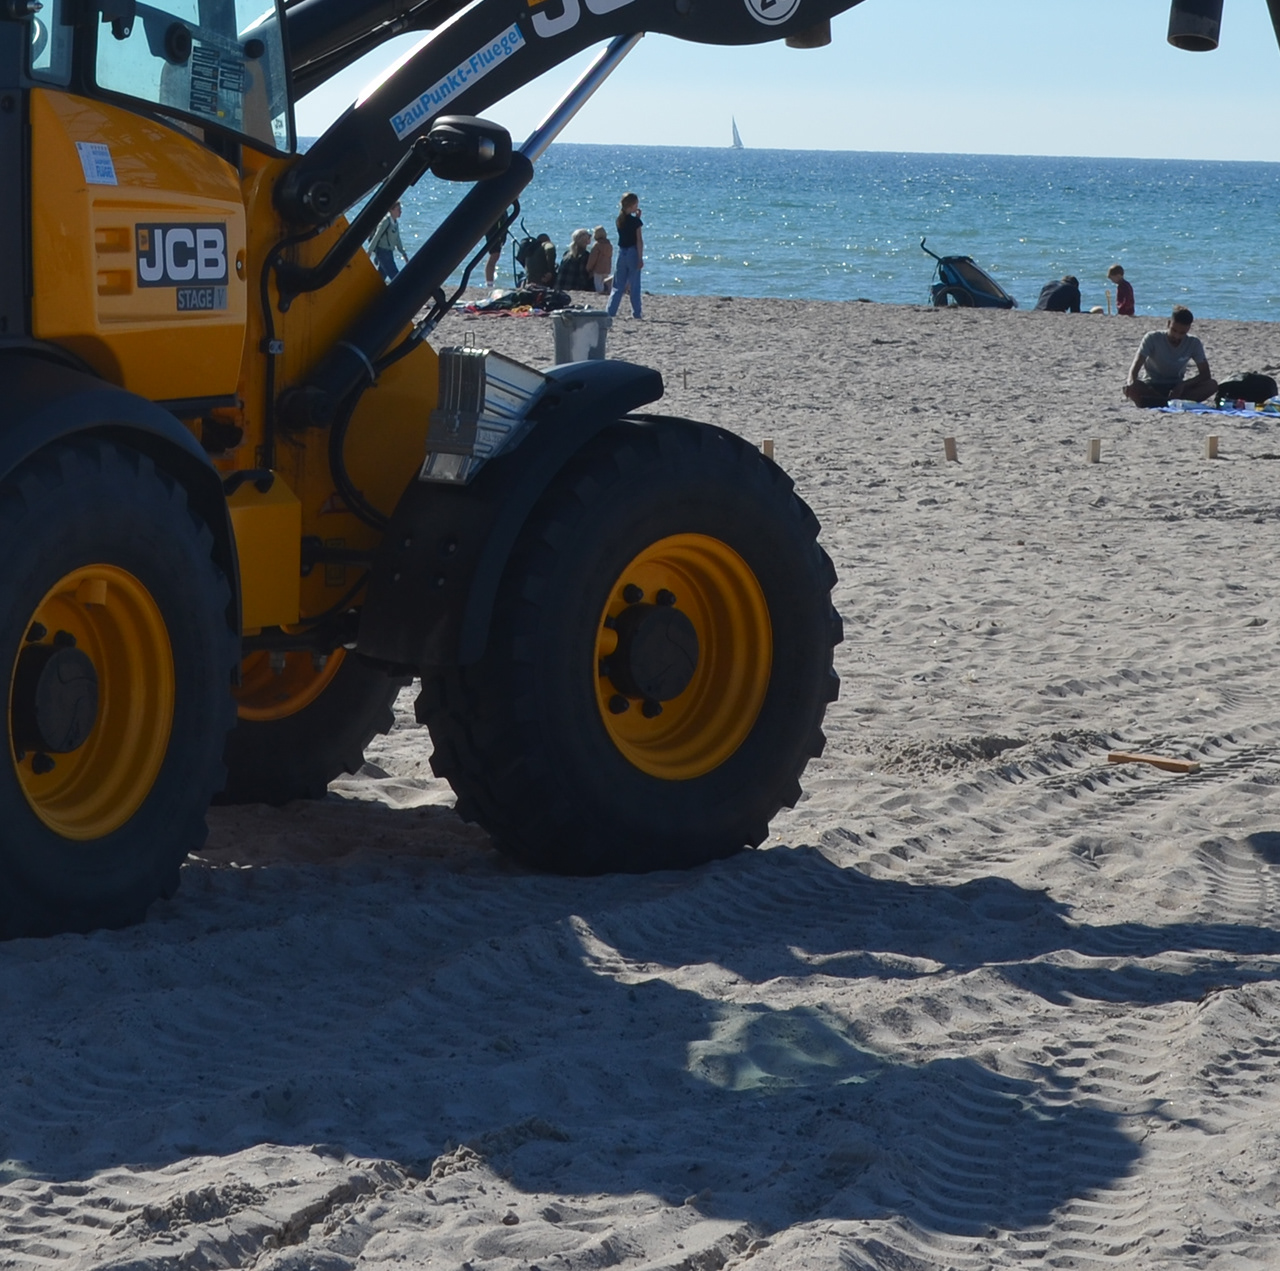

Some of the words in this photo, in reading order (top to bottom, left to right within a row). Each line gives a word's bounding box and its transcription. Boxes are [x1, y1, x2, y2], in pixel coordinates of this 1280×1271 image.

[391, 23, 524, 134] BauPunkt-Fluegel
[139, 227, 227, 281] JCB
[178, 289, 213, 309] STAGE
